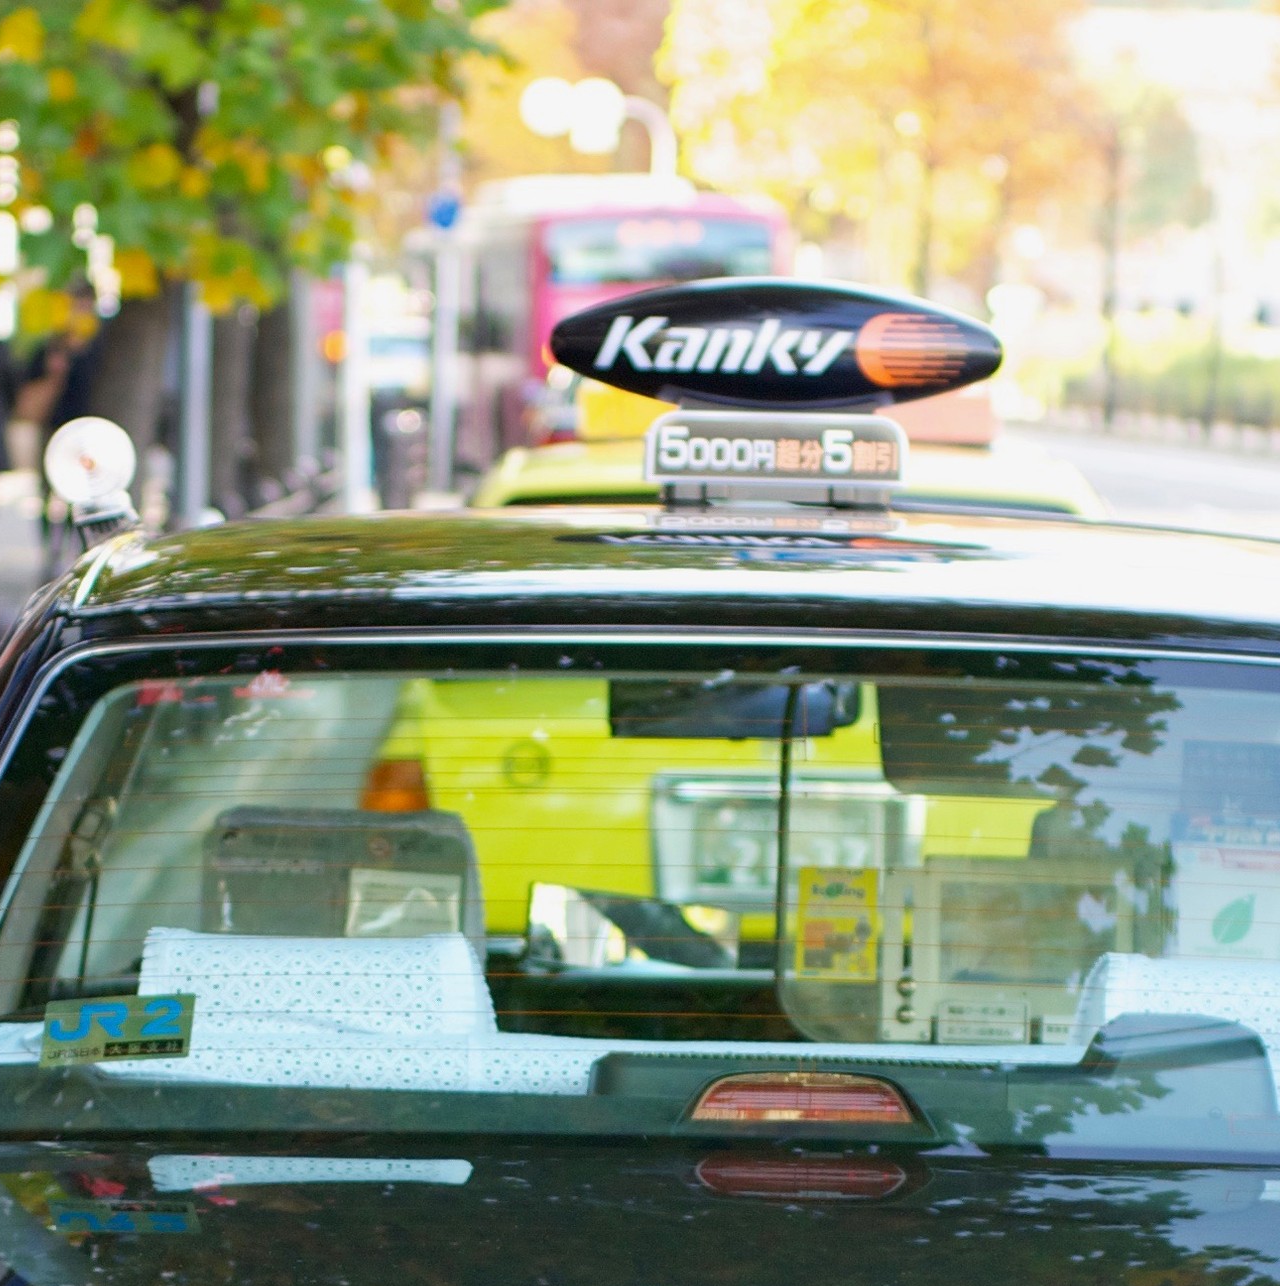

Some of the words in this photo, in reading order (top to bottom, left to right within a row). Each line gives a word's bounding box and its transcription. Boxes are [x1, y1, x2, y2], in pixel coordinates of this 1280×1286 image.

[593, 314, 856, 377] Kanky
[48, 1002, 128, 1043] JR
[140, 998, 183, 1036] 2
